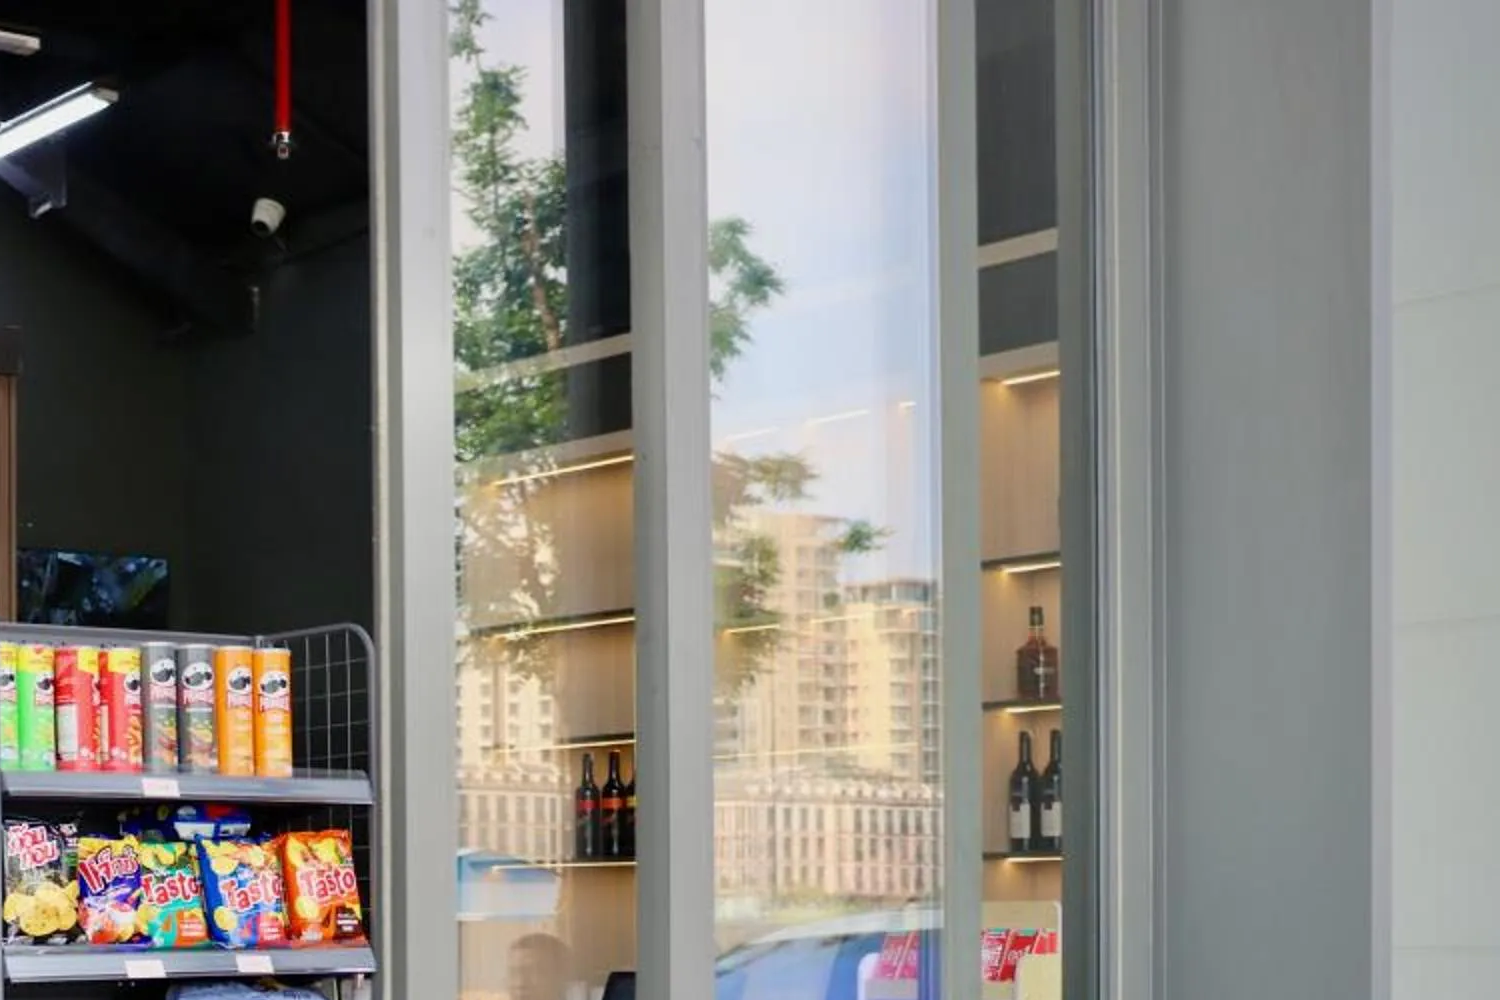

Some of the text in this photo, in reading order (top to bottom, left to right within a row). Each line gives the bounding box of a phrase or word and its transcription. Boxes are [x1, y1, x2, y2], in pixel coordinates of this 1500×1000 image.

[140, 871, 202, 907] Tasto
[219, 869, 282, 913] Tasto
[298, 867, 356, 906] Tasto
